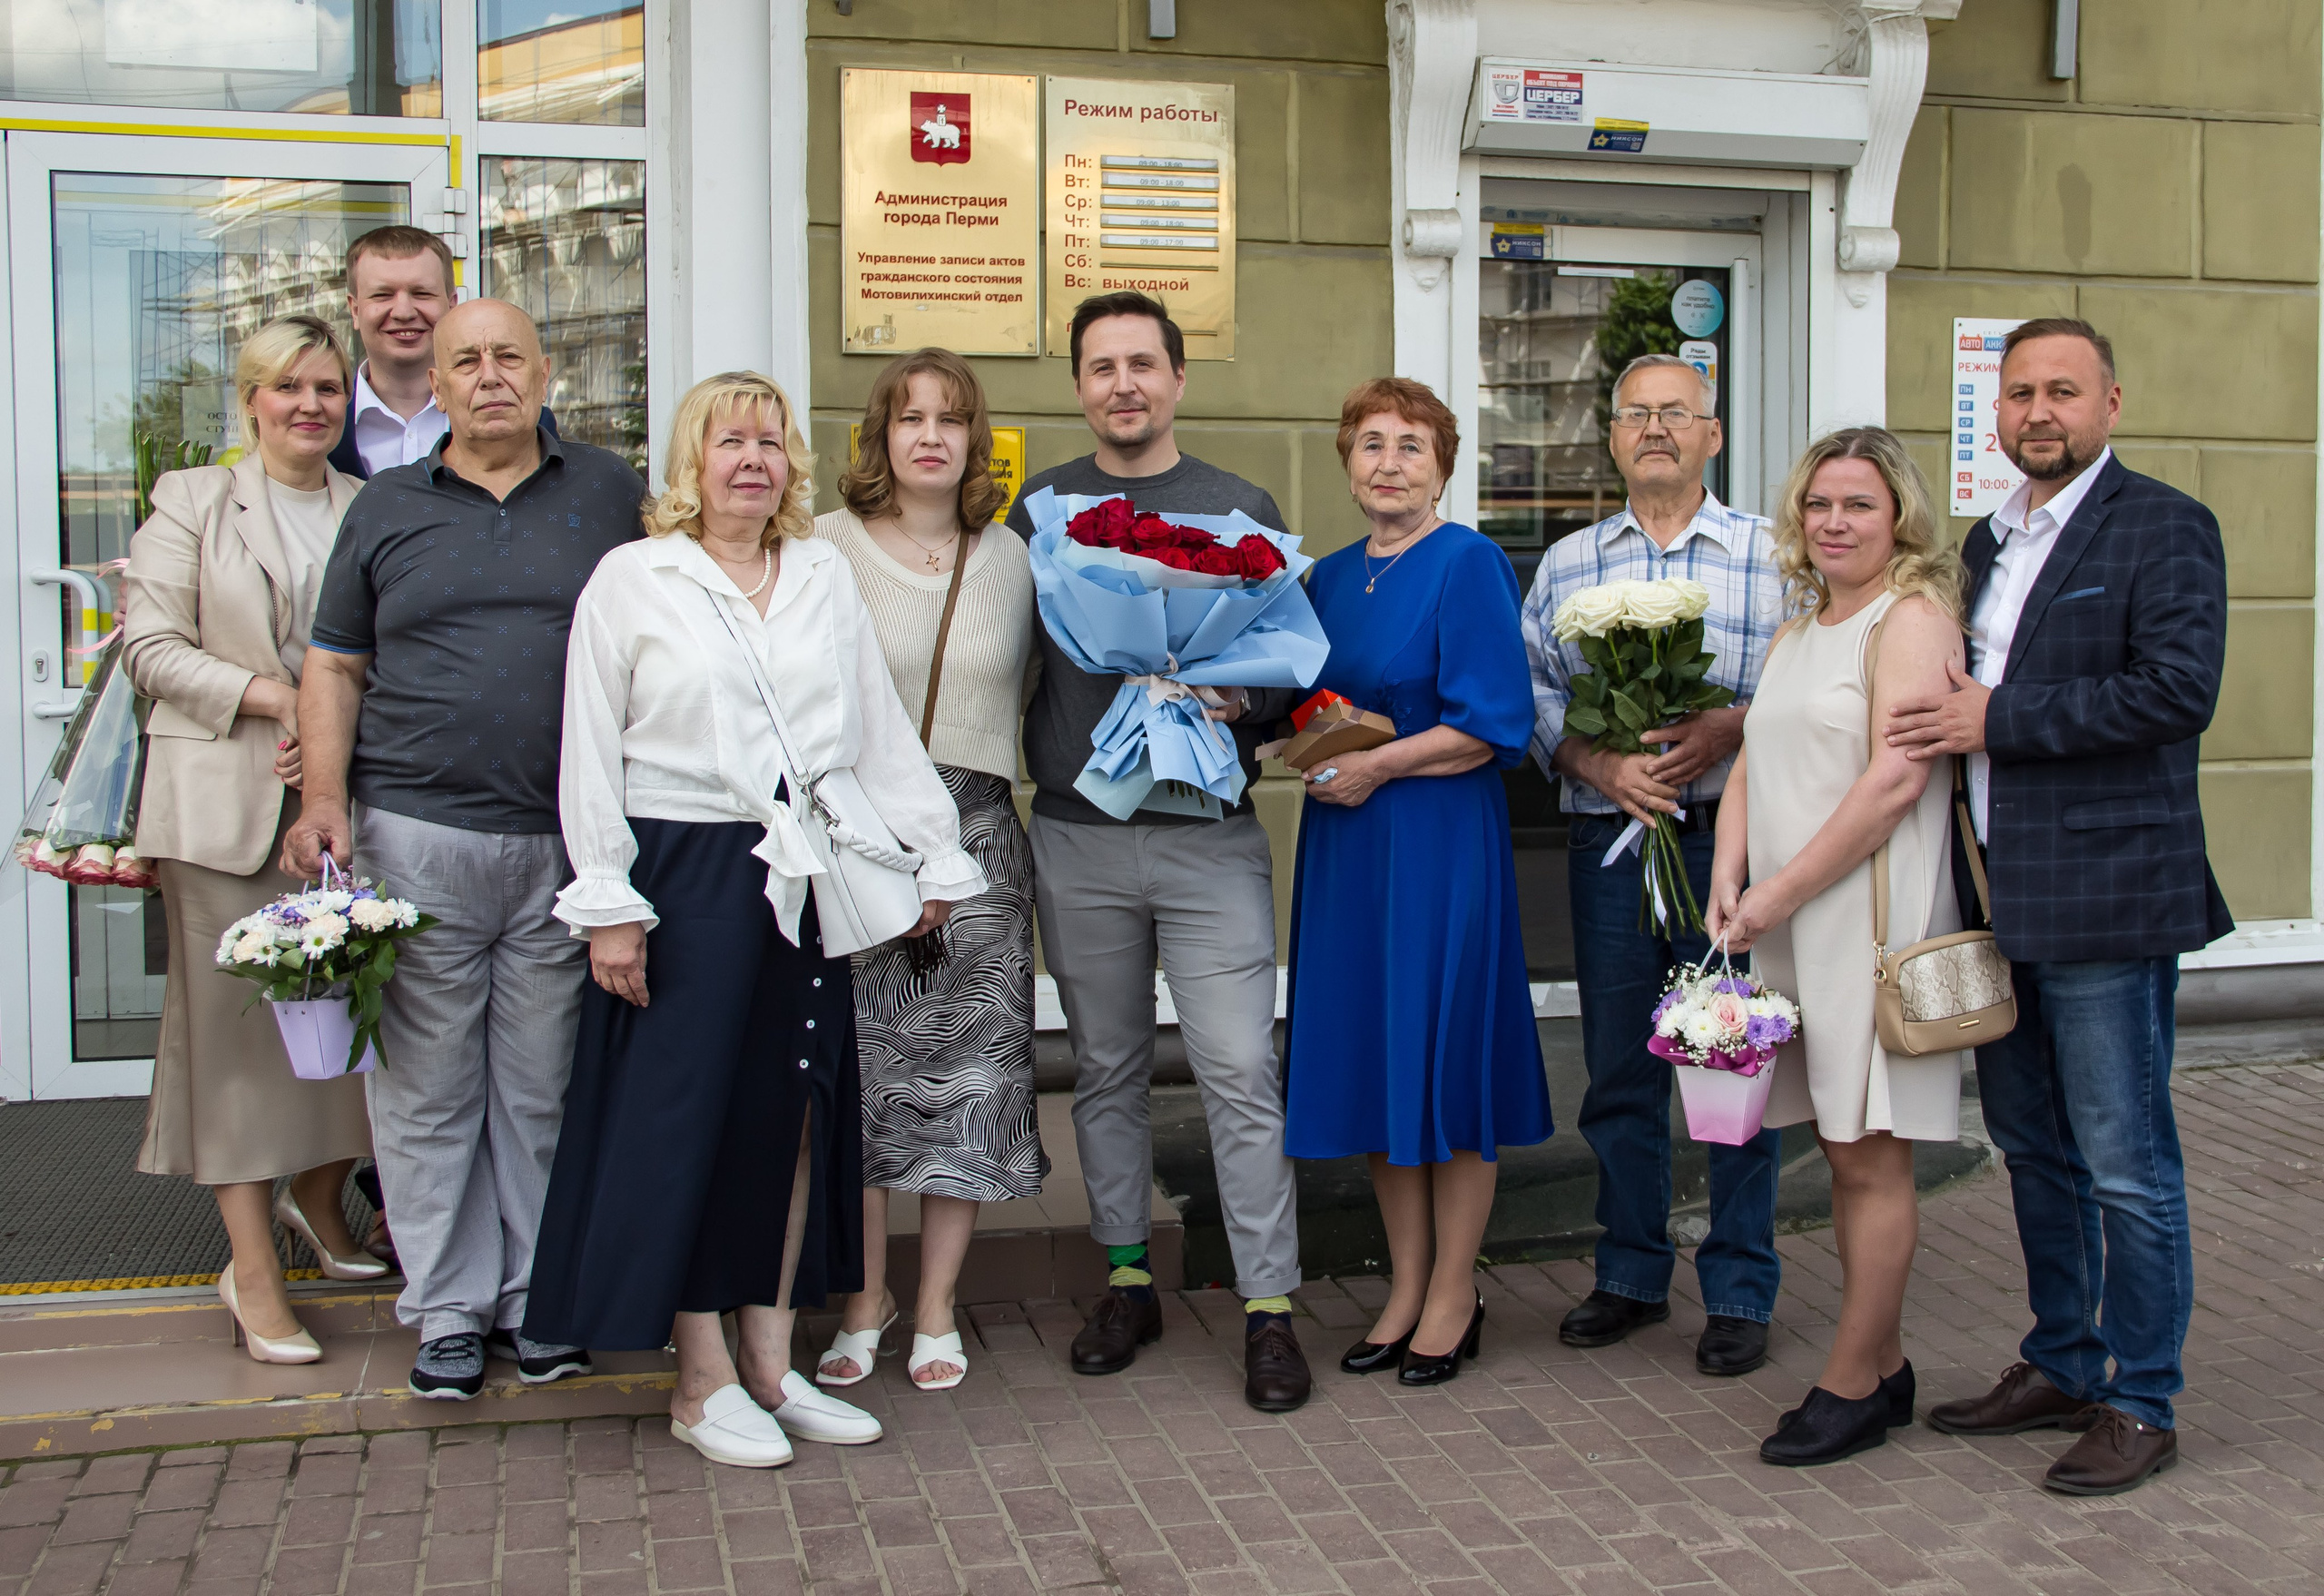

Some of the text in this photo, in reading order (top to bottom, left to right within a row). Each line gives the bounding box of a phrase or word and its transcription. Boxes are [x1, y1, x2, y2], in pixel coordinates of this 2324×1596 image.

[1526, 88, 1580, 104] ЦЕРБЕР
[1064, 99, 1218, 123] Режим работы
[1065, 154, 1092, 168] Пн:
[1065, 174, 1090, 188] Вт:
[1140, 178, 1159, 186] 09:00
[874, 190, 1008, 208] Администрация
[1065, 194, 1092, 211] Ср:
[883, 212, 1000, 228] города Перми
[1065, 214, 1090, 228] Чт:
[1065, 234, 1090, 248] Пт:
[858, 251, 1025, 267] Управление записи актов
[1065, 254, 1092, 269] Сб:
[861, 271, 1023, 285] гражданского состояния
[1064, 274, 1189, 292] Вс: выходной
[862, 288, 1023, 303] Мотовилихинский отдел
[1960, 339, 2002, 350] АВТО АКК
[1960, 419, 1971, 427] СР
[1960, 435, 1970, 443] ЧТ
[1978, 478, 2009, 489] 10:00
